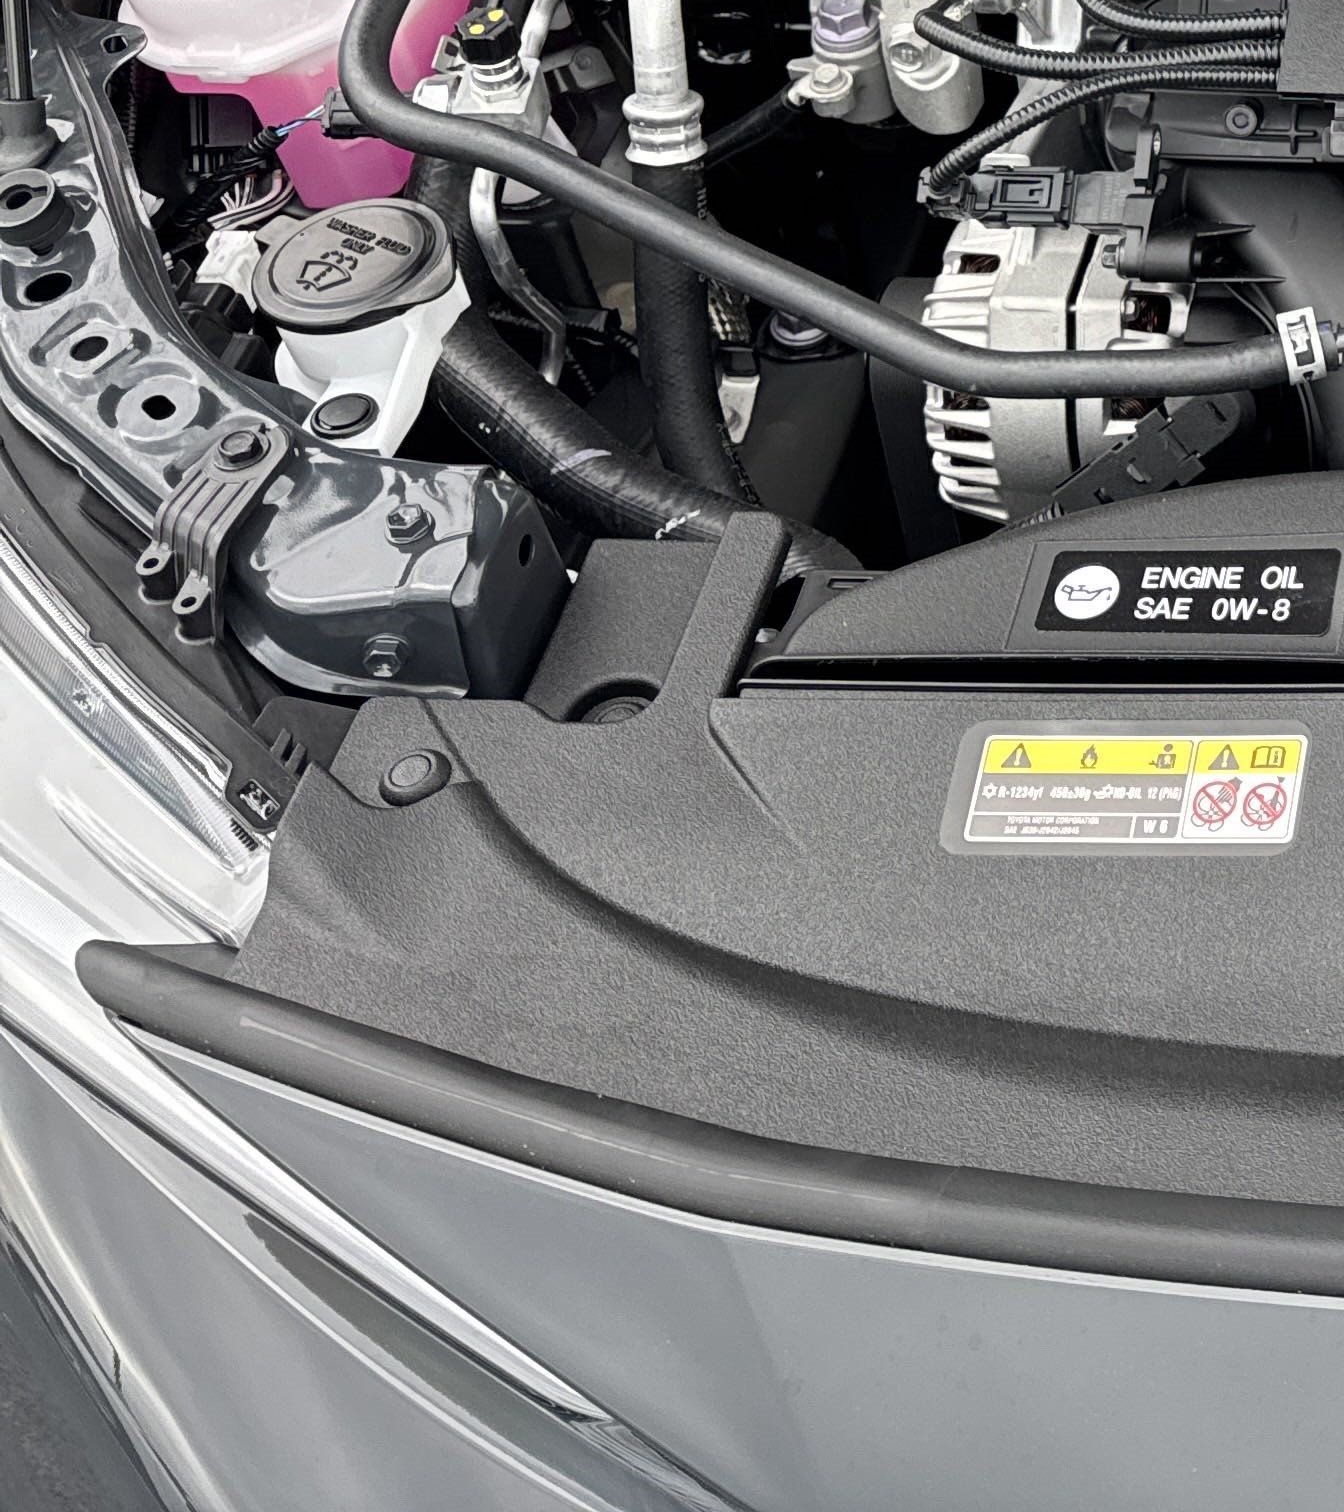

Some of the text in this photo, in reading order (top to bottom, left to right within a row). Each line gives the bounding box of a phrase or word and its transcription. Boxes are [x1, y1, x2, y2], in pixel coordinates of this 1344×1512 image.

[326, 217, 412, 256] WASHER FLUID
[341, 237, 375, 255] ONLY
[1141, 565, 1304, 590] ENGINE OIL
[1133, 596, 1291, 621] SAE 0W-8
[1032, 816, 1054, 825] MOTOR
